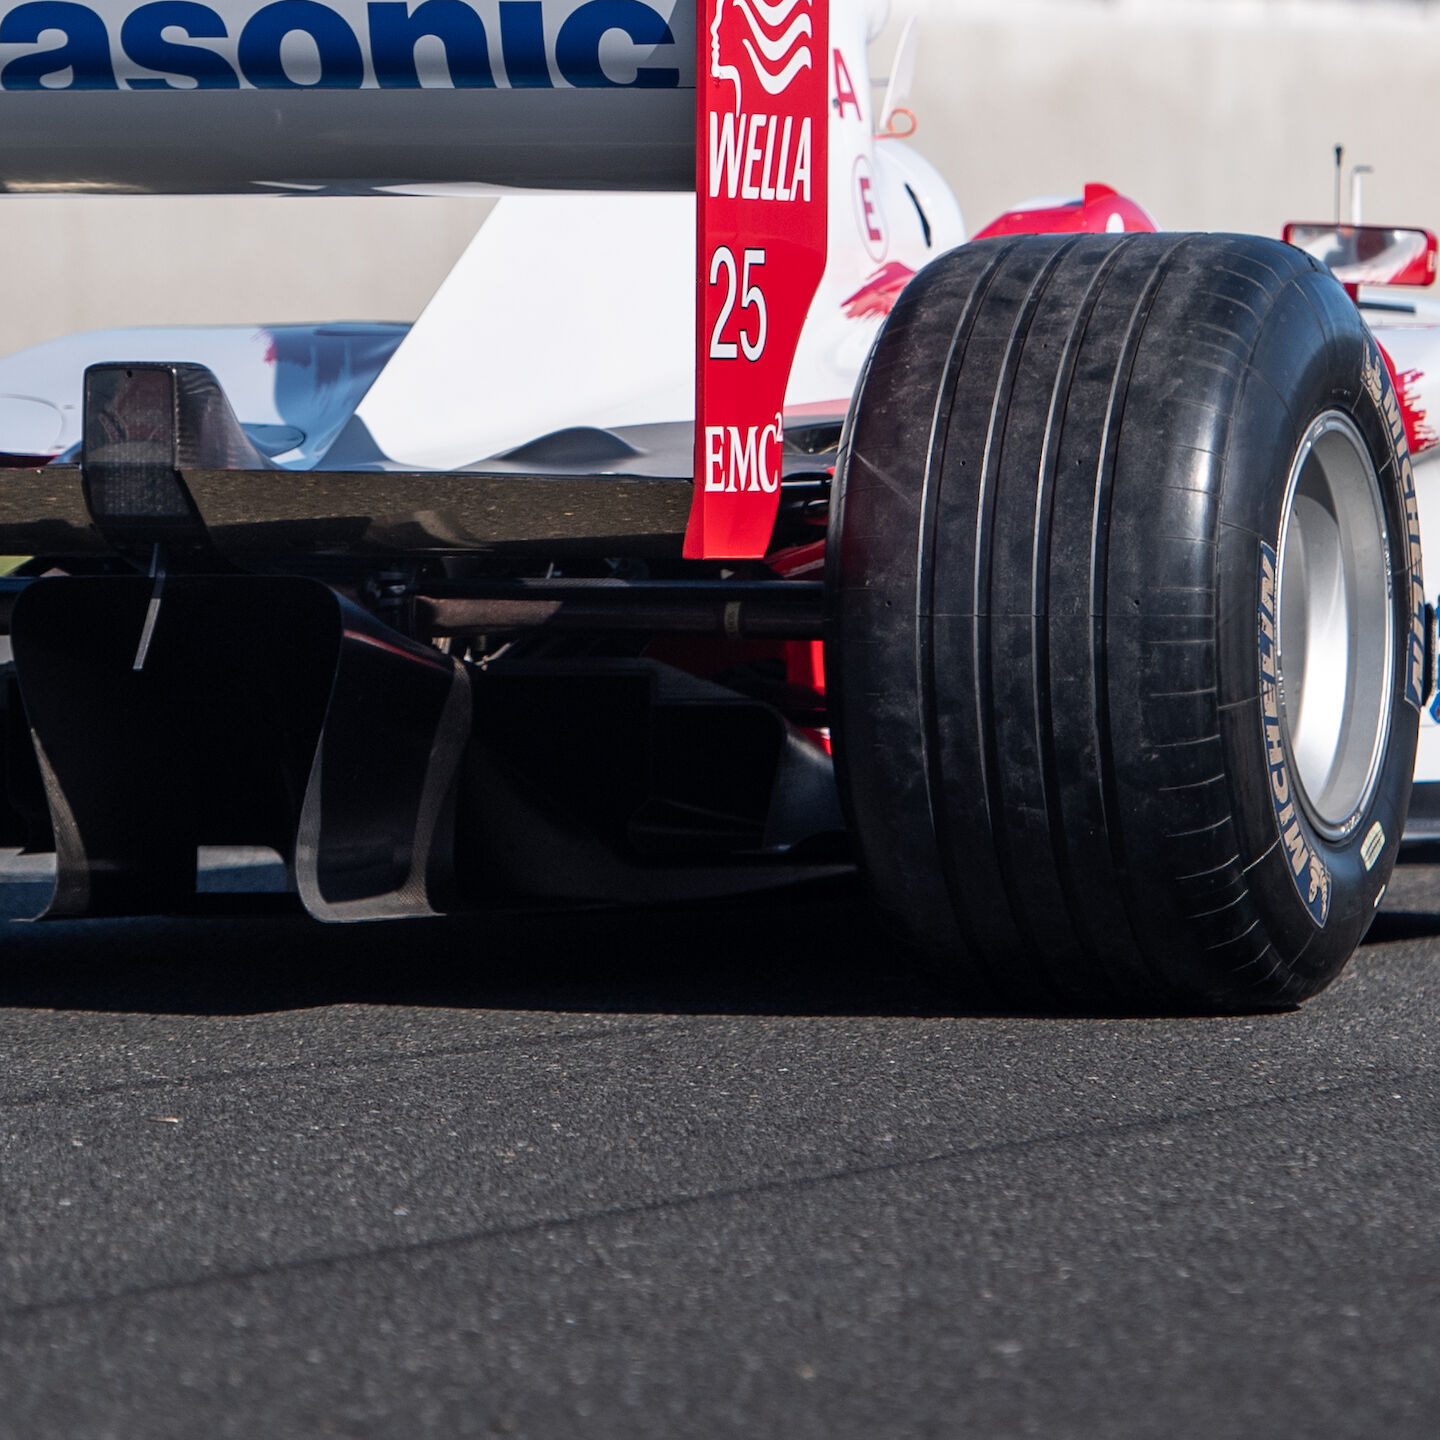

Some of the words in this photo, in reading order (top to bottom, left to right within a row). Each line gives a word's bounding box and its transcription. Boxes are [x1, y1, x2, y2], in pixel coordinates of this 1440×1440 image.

[709, 111, 812, 203] WELLA
[708, 244, 768, 362] 25
[1260, 550, 1310, 876] MICHELIN
